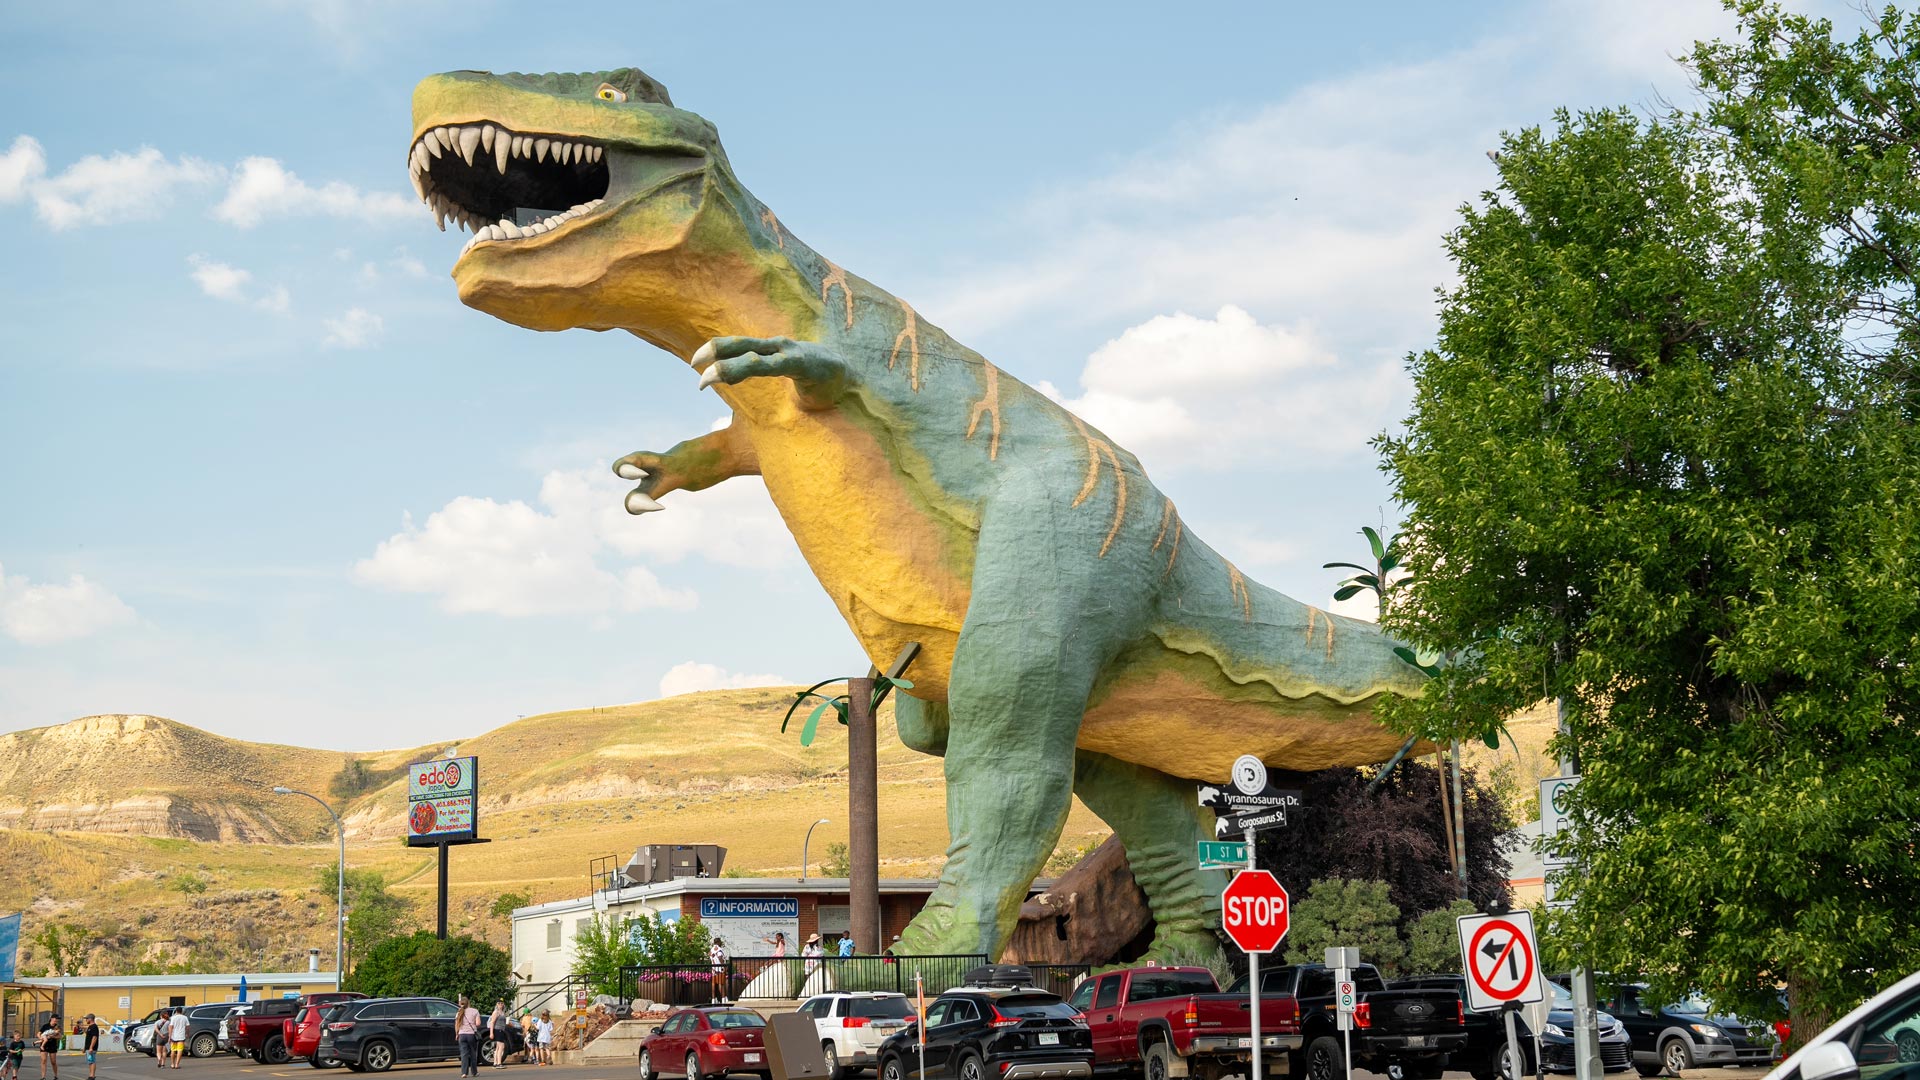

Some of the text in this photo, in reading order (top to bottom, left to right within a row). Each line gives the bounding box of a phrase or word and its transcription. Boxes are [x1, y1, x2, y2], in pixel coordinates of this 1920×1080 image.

[419, 766, 445, 786] edo
[1222, 792, 1299, 806] Tyrannosaurus Dr.
[1238, 811, 1285, 829] Gorgosaurus St.
[1206, 844, 1243, 860] 1 ST W
[720, 902, 795, 913] INFORMATION
[1228, 896, 1284, 926] STOP
